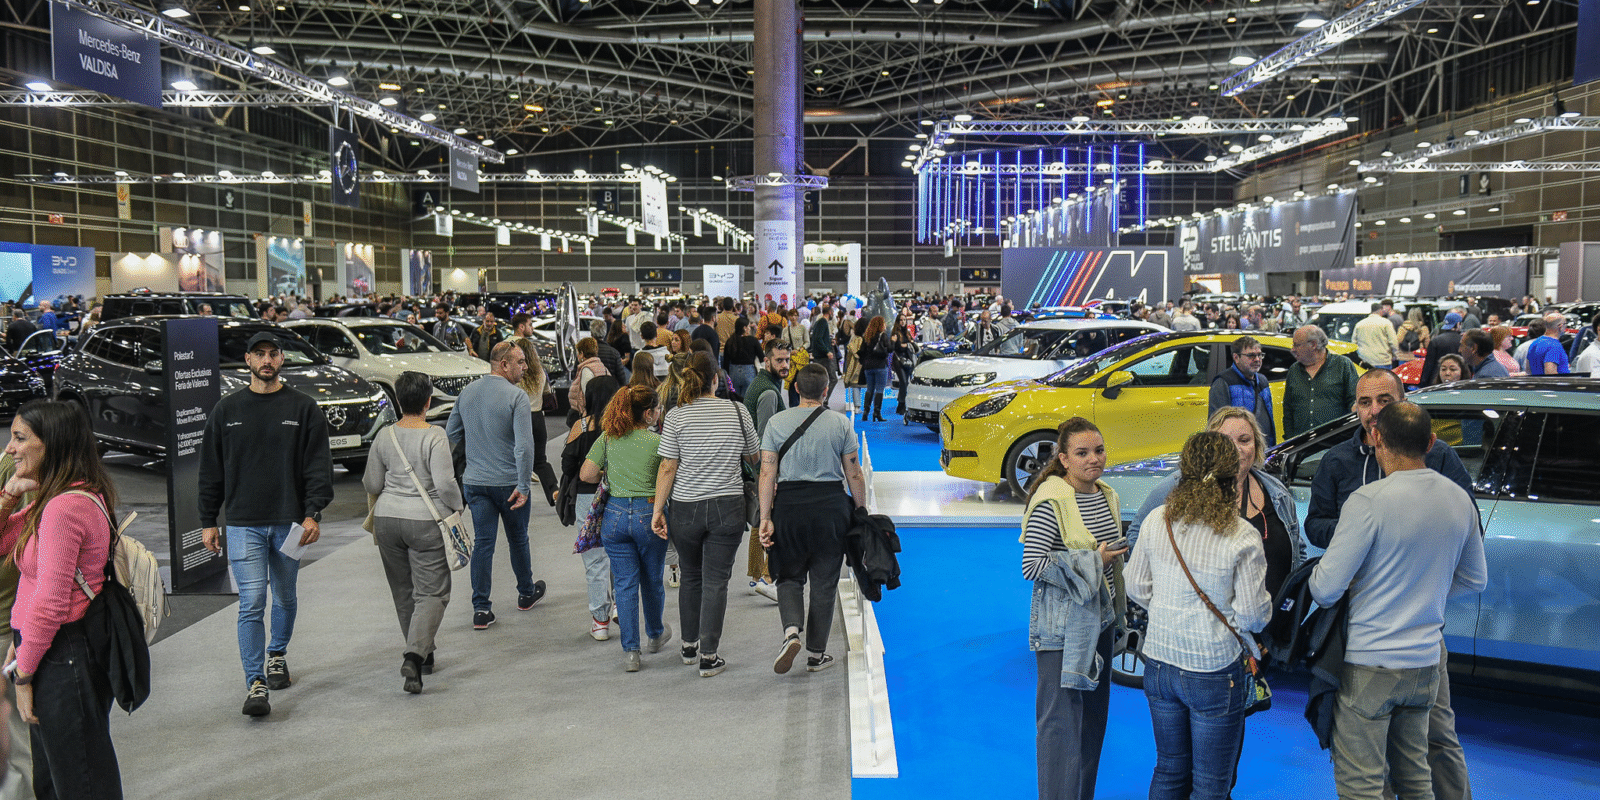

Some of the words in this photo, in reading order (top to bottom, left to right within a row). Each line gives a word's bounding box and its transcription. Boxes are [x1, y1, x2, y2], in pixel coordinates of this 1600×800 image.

[78, 28, 141, 64] Mercedes-Benz
[78, 52, 118, 80] VALDISA
[423, 192, 434, 202] A
[604, 191, 612, 202] B
[804, 192, 811, 202] C
[1210, 228, 1282, 254] STELLANTIS
[52, 255, 76, 266] BYD
[174, 351, 190, 360] Polestar
[190, 350, 194, 359] 2
[174, 370, 191, 380] Ofertas
[191, 368, 212, 378] Exclusivas
[175, 380, 186, 390] Feria
[187, 380, 192, 389] de
[192, 378, 209, 388] Valencia
